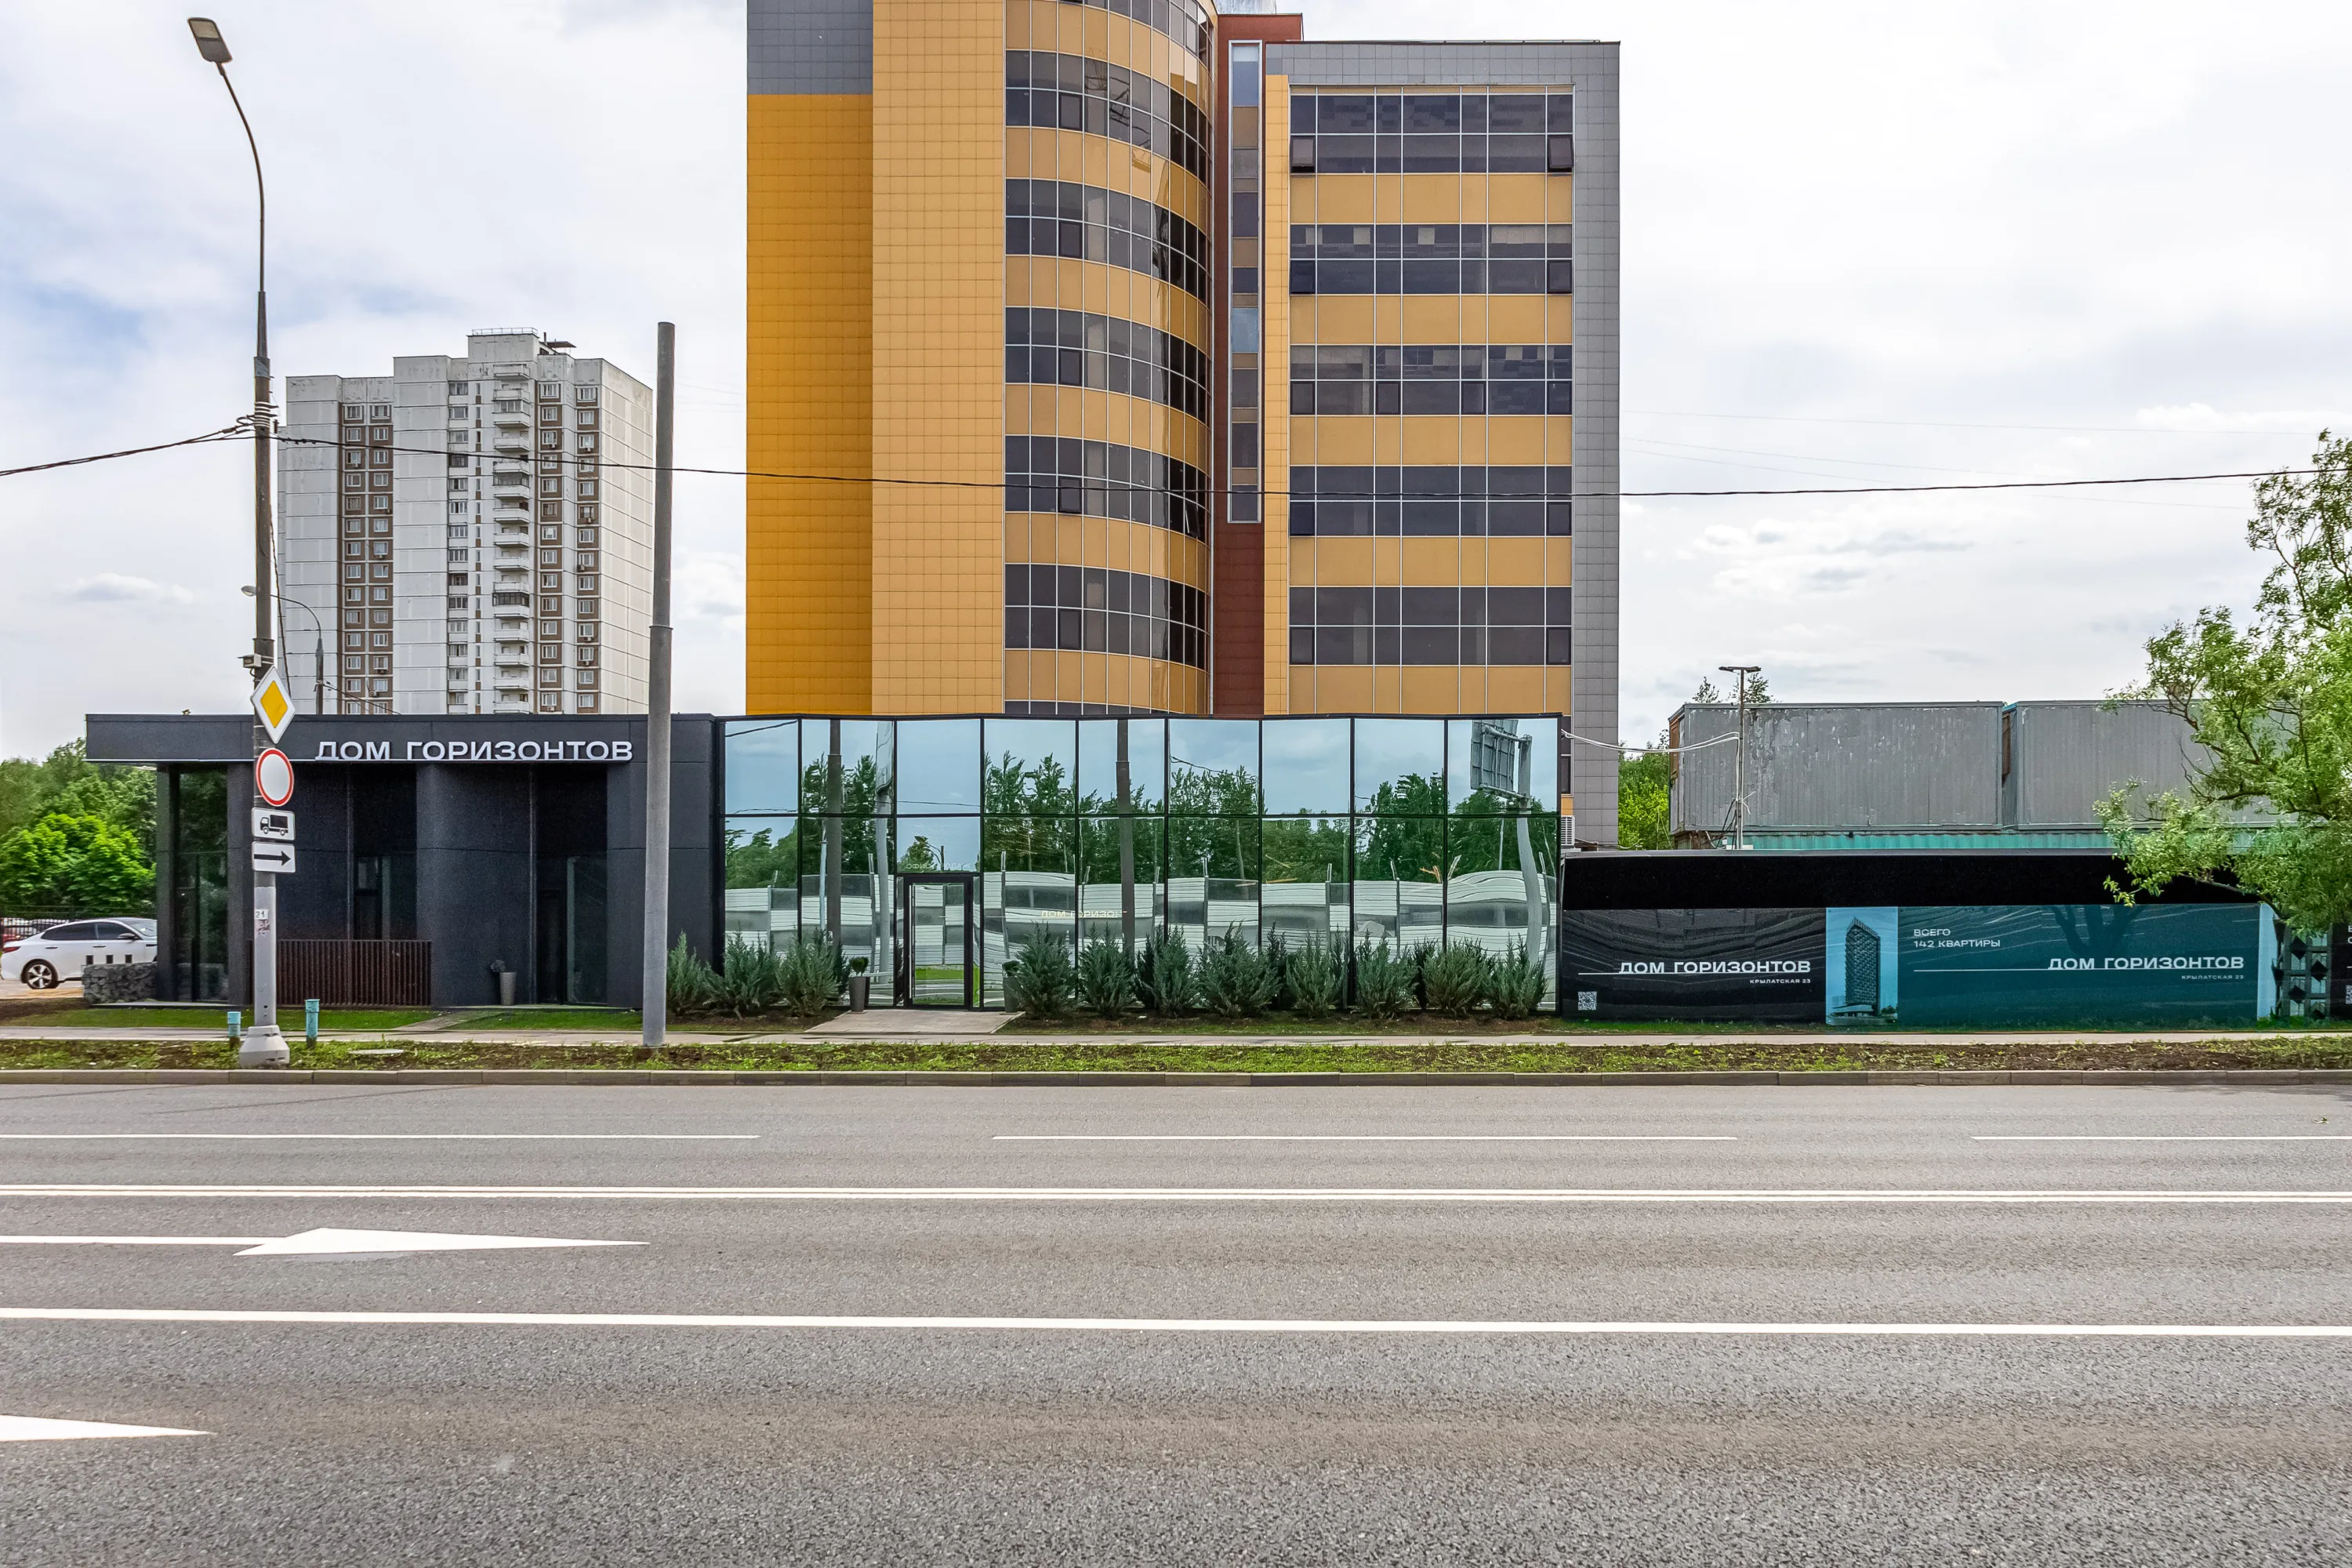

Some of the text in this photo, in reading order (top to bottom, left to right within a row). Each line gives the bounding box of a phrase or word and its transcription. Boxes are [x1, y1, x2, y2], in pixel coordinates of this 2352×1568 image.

[315, 741, 633, 761] ДОМ ГОРИЗОНТОВ
[1618, 960, 1811, 973] ДОМ ГОРИЗОНТОВ
[2048, 956, 2244, 969] ДОМ ГОРИЗОНТОВ
